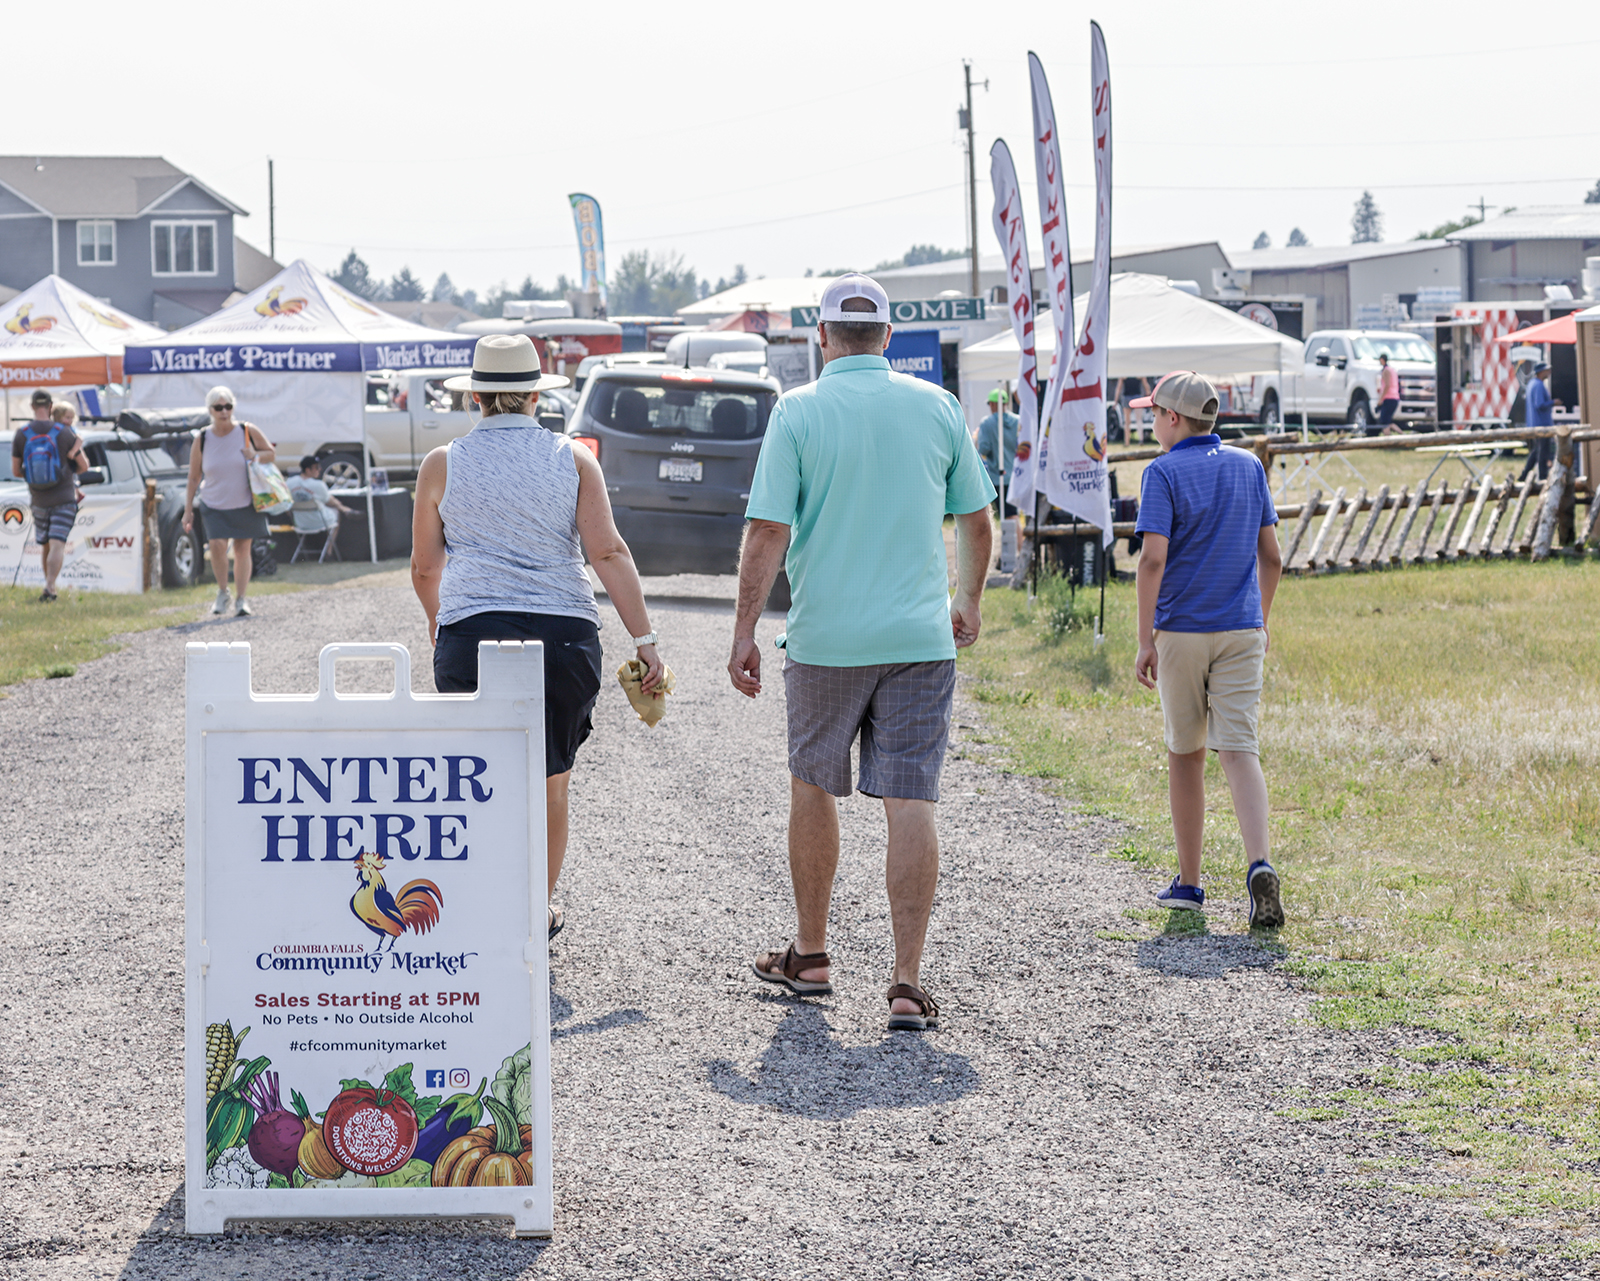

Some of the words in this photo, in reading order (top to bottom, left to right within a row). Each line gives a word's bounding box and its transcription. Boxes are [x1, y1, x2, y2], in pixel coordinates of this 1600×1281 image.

[800, 299, 983, 325] WOME!
[150, 348, 234, 371] Market
[239, 346, 336, 368] Partner
[375, 344, 421, 368] Market
[421, 343, 471, 365] Partner
[891, 357, 934, 372] MARKET
[671, 442, 695, 453] Jeep
[91, 536, 135, 548] VFW
[237, 755, 494, 804] ENTER
[260, 813, 469, 862] HERE
[273, 944, 330, 954] COLUMBIA
[331, 944, 364, 953] FALLS
[255, 952, 384, 976] Community
[390, 951, 479, 976] Market
[254, 993, 310, 1008] Sales
[316, 991, 402, 1010] Starting
[408, 991, 430, 1006] at
[436, 992, 480, 1006] 5PM
[262, 1014, 282, 1025] No
[287, 1014, 319, 1025] Pets
[334, 1013, 354, 1024] No
[358, 1012, 416, 1024] Outside
[419, 1011, 474, 1024] Alcohol
[289, 1038, 448, 1053] #cfcommunitymarket
[331, 1125, 363, 1172] DONATIONS
[364, 1144, 409, 1173] WELCOME!
